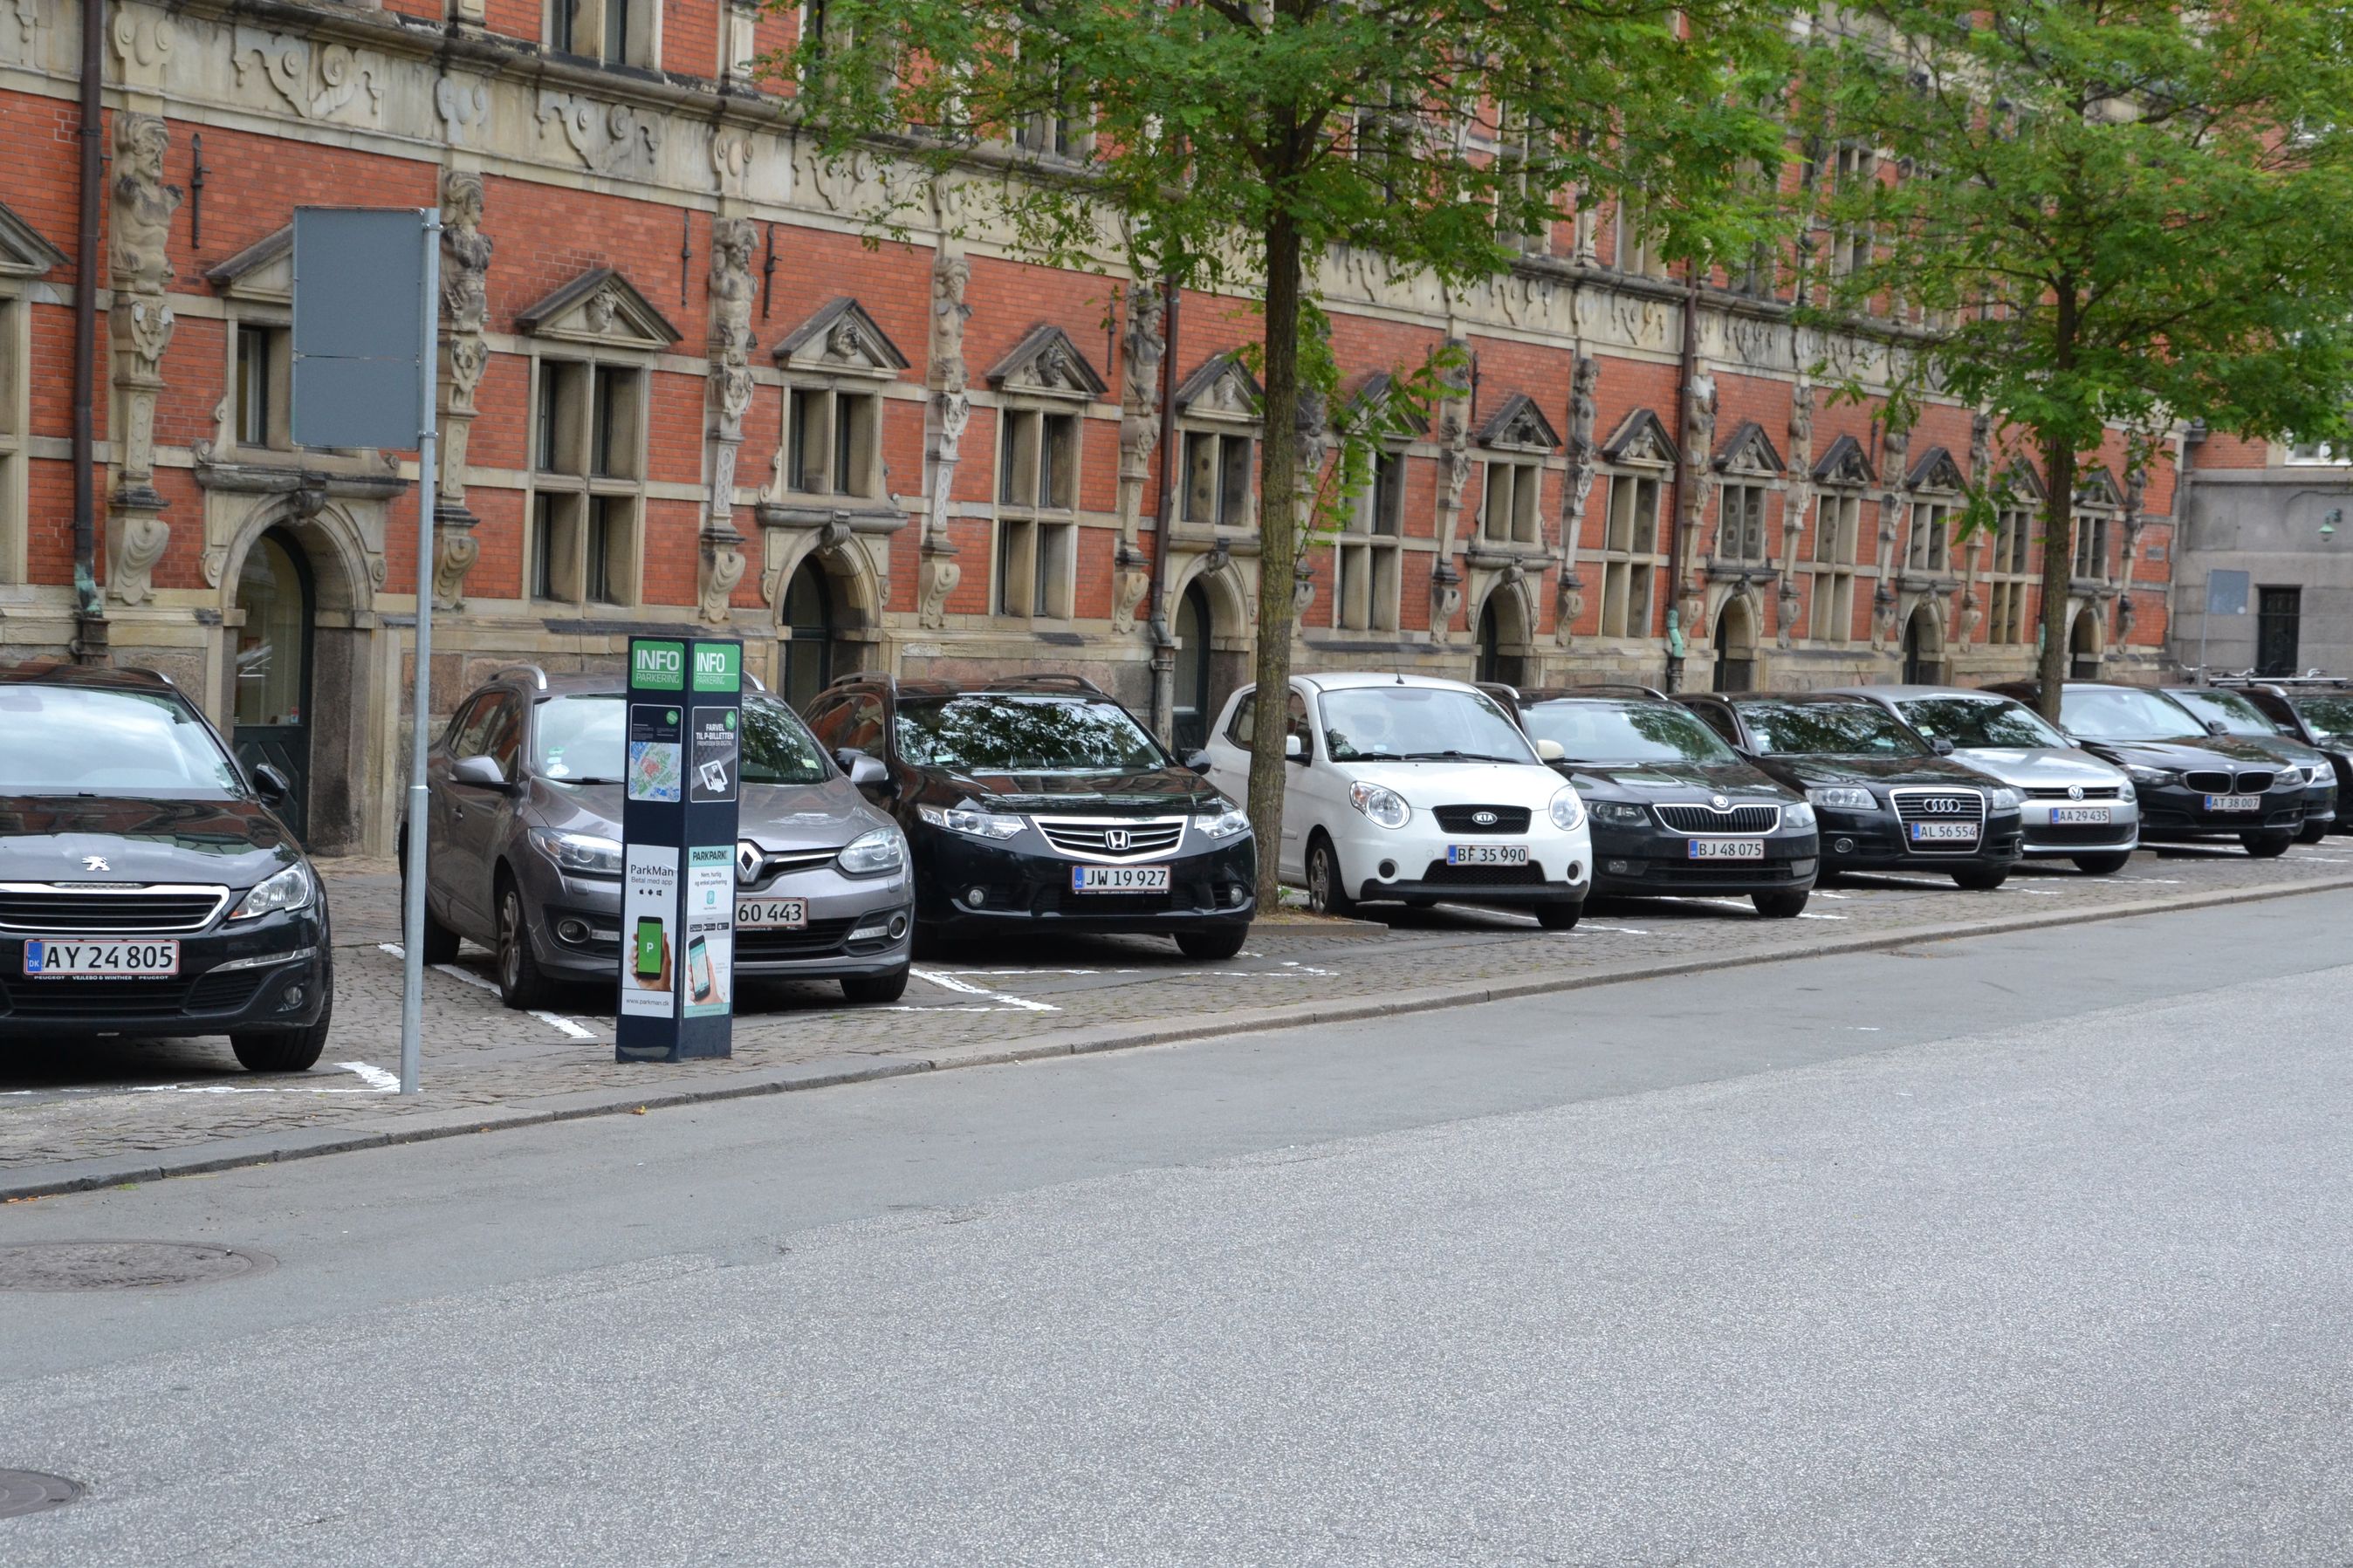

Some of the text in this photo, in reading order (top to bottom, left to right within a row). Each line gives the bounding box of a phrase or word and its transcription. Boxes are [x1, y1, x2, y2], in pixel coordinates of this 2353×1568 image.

[636, 649, 680, 671] INFO
[696, 652, 725, 673] INFO
[636, 673, 680, 684] PARKERING
[696, 676, 725, 685] PARKERING
[711, 764, 718, 773] P
[2212, 798, 2259, 808] AT 38 007
[2061, 811, 2108, 821] AA 29 435
[1921, 825, 1976, 838] AL 56 554
[1458, 848, 1526, 862] BF 35 990
[1699, 843, 1761, 855] BJ 48 075
[630, 864, 674, 876] ParkMan
[1087, 870, 1167, 886] JW 19 927
[737, 903, 802, 921] 60 443
[646, 941, 654, 953] P
[45, 946, 173, 969] AY 24 805
[626, 998, 670, 1007] www.parkman.dk
